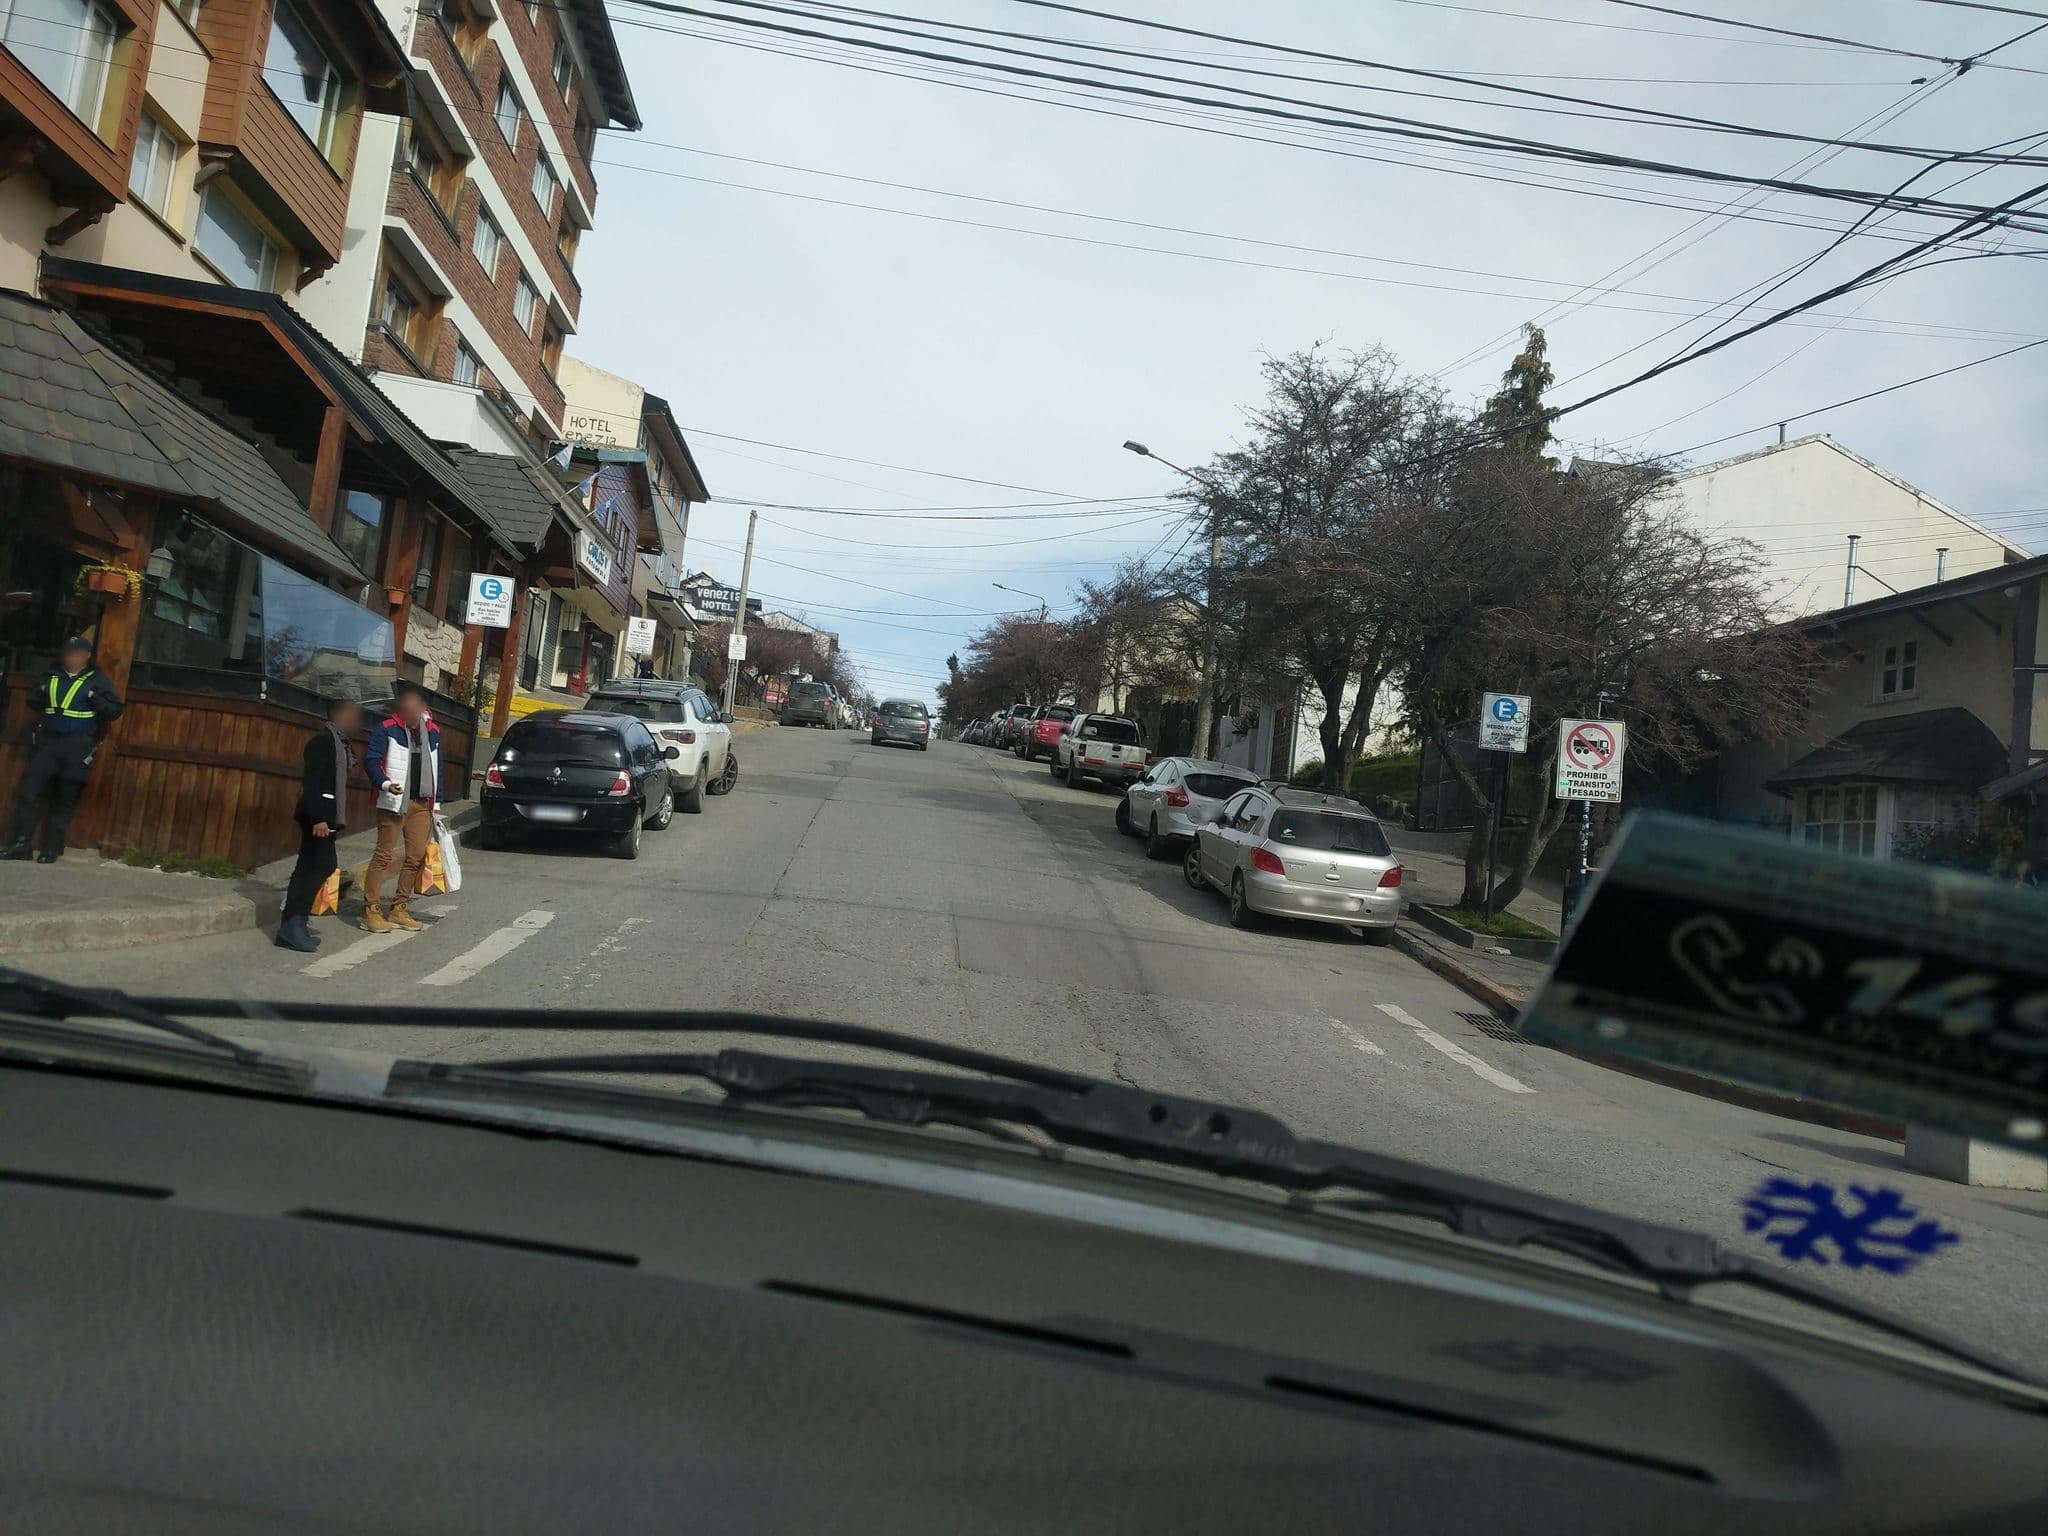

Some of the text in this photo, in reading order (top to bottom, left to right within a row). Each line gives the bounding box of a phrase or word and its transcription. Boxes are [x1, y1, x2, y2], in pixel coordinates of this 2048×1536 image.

[570, 416, 612, 433] HOTEL
[485, 581, 498, 597] E
[701, 600, 735, 611] HOTEL
[1499, 701, 1512, 719] E
[1568, 780, 1611, 789] TRANSITO
[1572, 788, 1606, 797] PESADO
